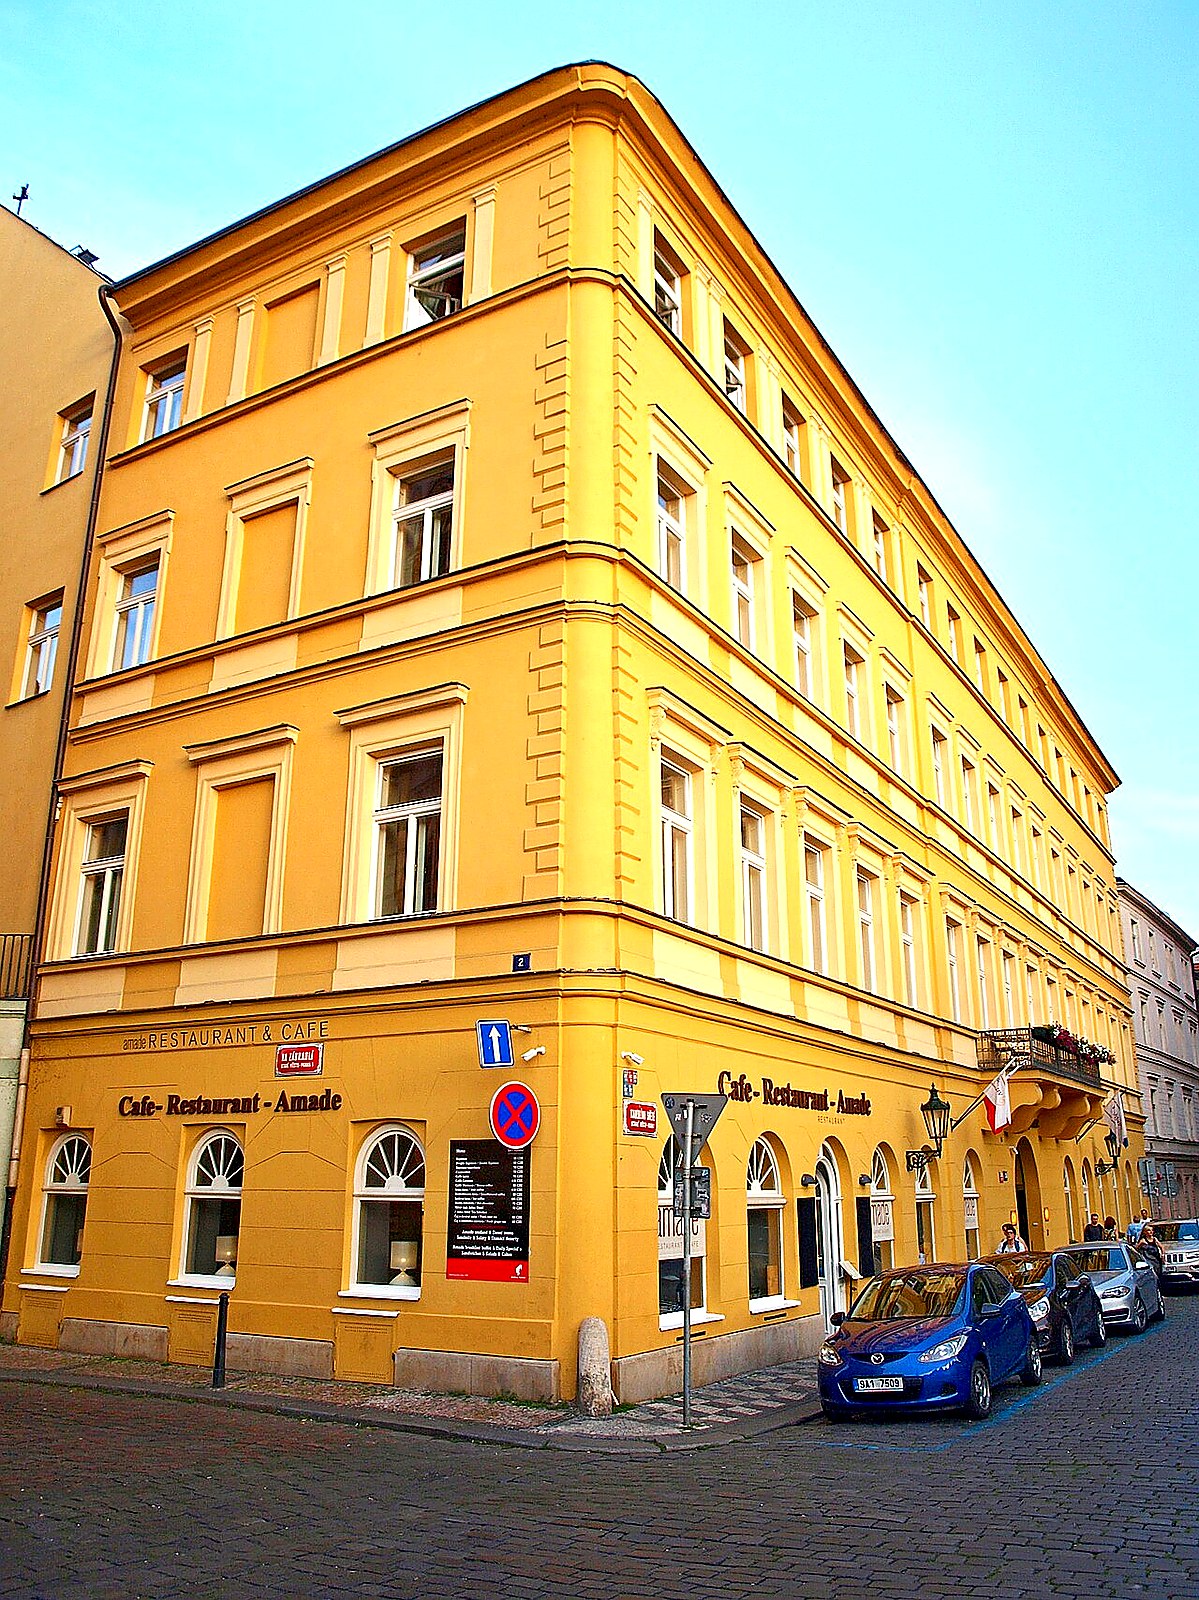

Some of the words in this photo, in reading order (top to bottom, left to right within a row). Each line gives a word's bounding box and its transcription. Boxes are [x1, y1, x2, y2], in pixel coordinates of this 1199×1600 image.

[517, 957, 524, 967] 2
[148, 1026, 258, 1049] RESTAURANT
[262, 1025, 272, 1041] &
[281, 1020, 330, 1040] CAFE
[166, 1092, 261, 1115] Restaurant
[274, 1088, 343, 1113] Amade
[761, 1077, 829, 1111] Restaurant
[836, 1089, 872, 1116] Amade
[880, 1378, 900, 1388] 7509
